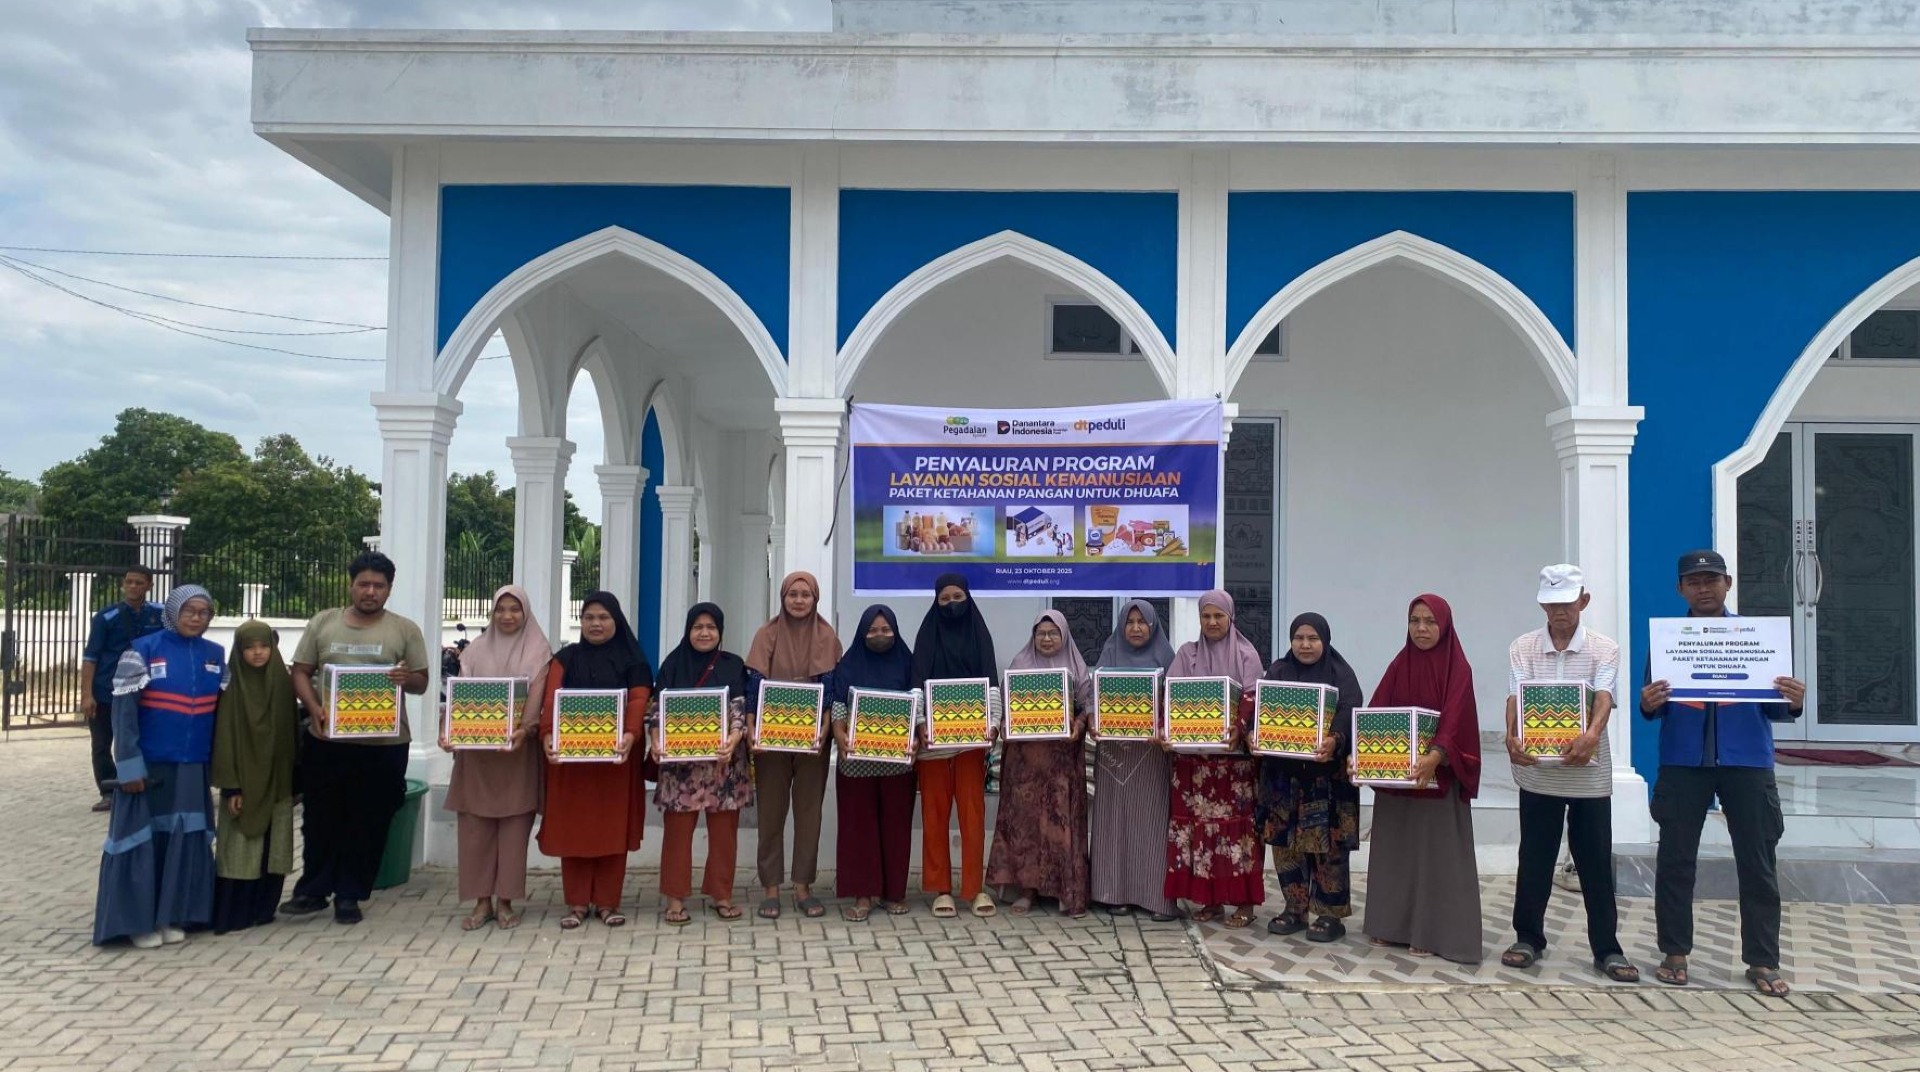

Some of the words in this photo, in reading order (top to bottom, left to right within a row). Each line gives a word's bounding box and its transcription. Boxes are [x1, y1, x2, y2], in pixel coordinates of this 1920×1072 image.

[1012, 419, 1055, 427] Danantara
[943, 425, 987, 436] Pegadaian
[915, 456, 1048, 472] PENYALURAN
[1052, 455, 1155, 471] PROGRAM
[890, 473, 975, 487] LAYANAN
[978, 472, 1040, 487] SOSIAL
[1045, 472, 1181, 486] KEMANUSIAAN
[889, 488, 932, 498] PAKET
[933, 488, 1016, 499] KETAHANAN
[1017, 488, 1074, 499] PANGAN
[1075, 488, 1120, 498] UNTUK
[1123, 487, 1179, 498] DHUAFA
